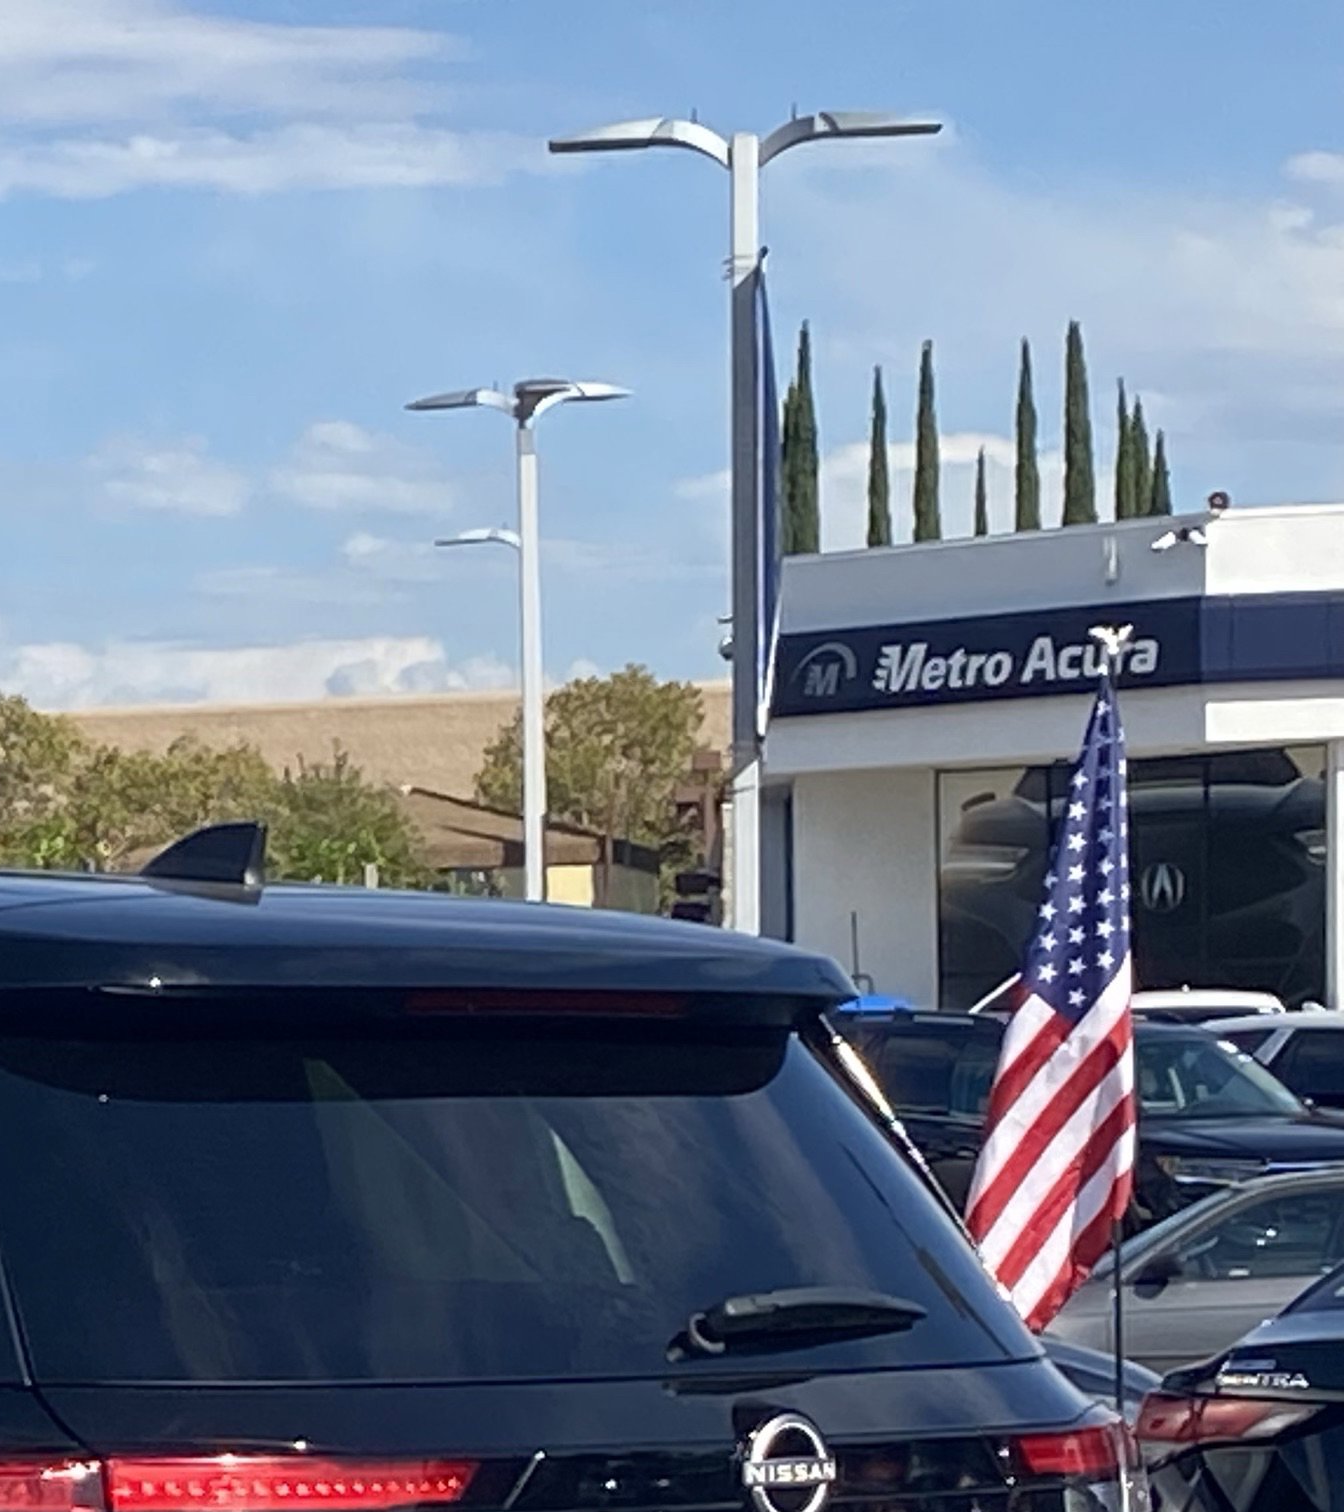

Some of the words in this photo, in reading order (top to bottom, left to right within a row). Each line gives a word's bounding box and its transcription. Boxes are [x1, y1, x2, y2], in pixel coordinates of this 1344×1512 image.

[873, 643, 1013, 692] Metro
[1020, 636, 1159, 684] Acura
[744, 1461, 836, 1484] NISSAN
